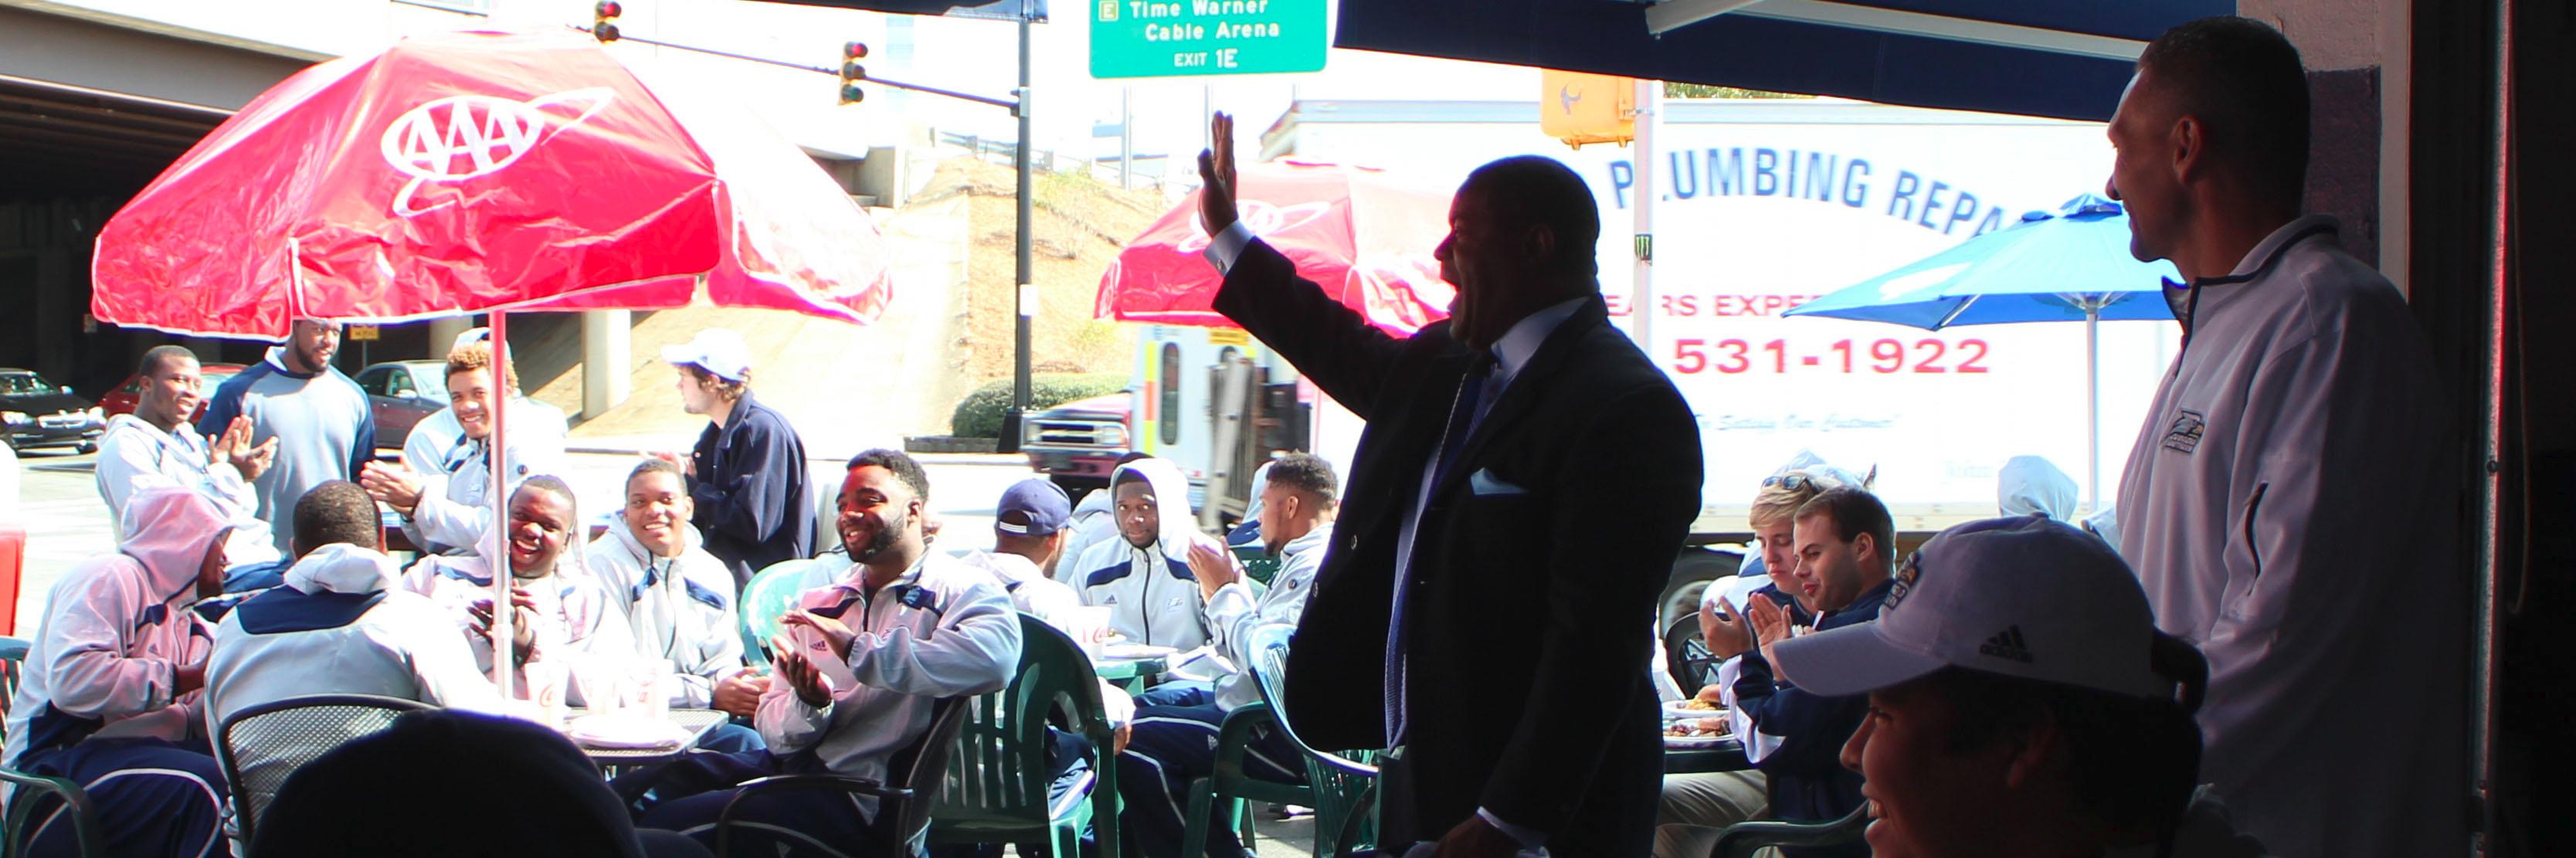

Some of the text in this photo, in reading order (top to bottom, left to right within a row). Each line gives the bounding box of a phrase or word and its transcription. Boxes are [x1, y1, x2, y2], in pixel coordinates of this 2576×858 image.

[1129, 0, 1268, 19] Time Warner
[1145, 21, 1280, 42] Cable Arena
[1173, 48, 1239, 69] EXIT 1E
[392, 98, 537, 177] AAA
[1607, 147, 1871, 209] PUMBING
[1673, 337, 1990, 375] 531-1922
